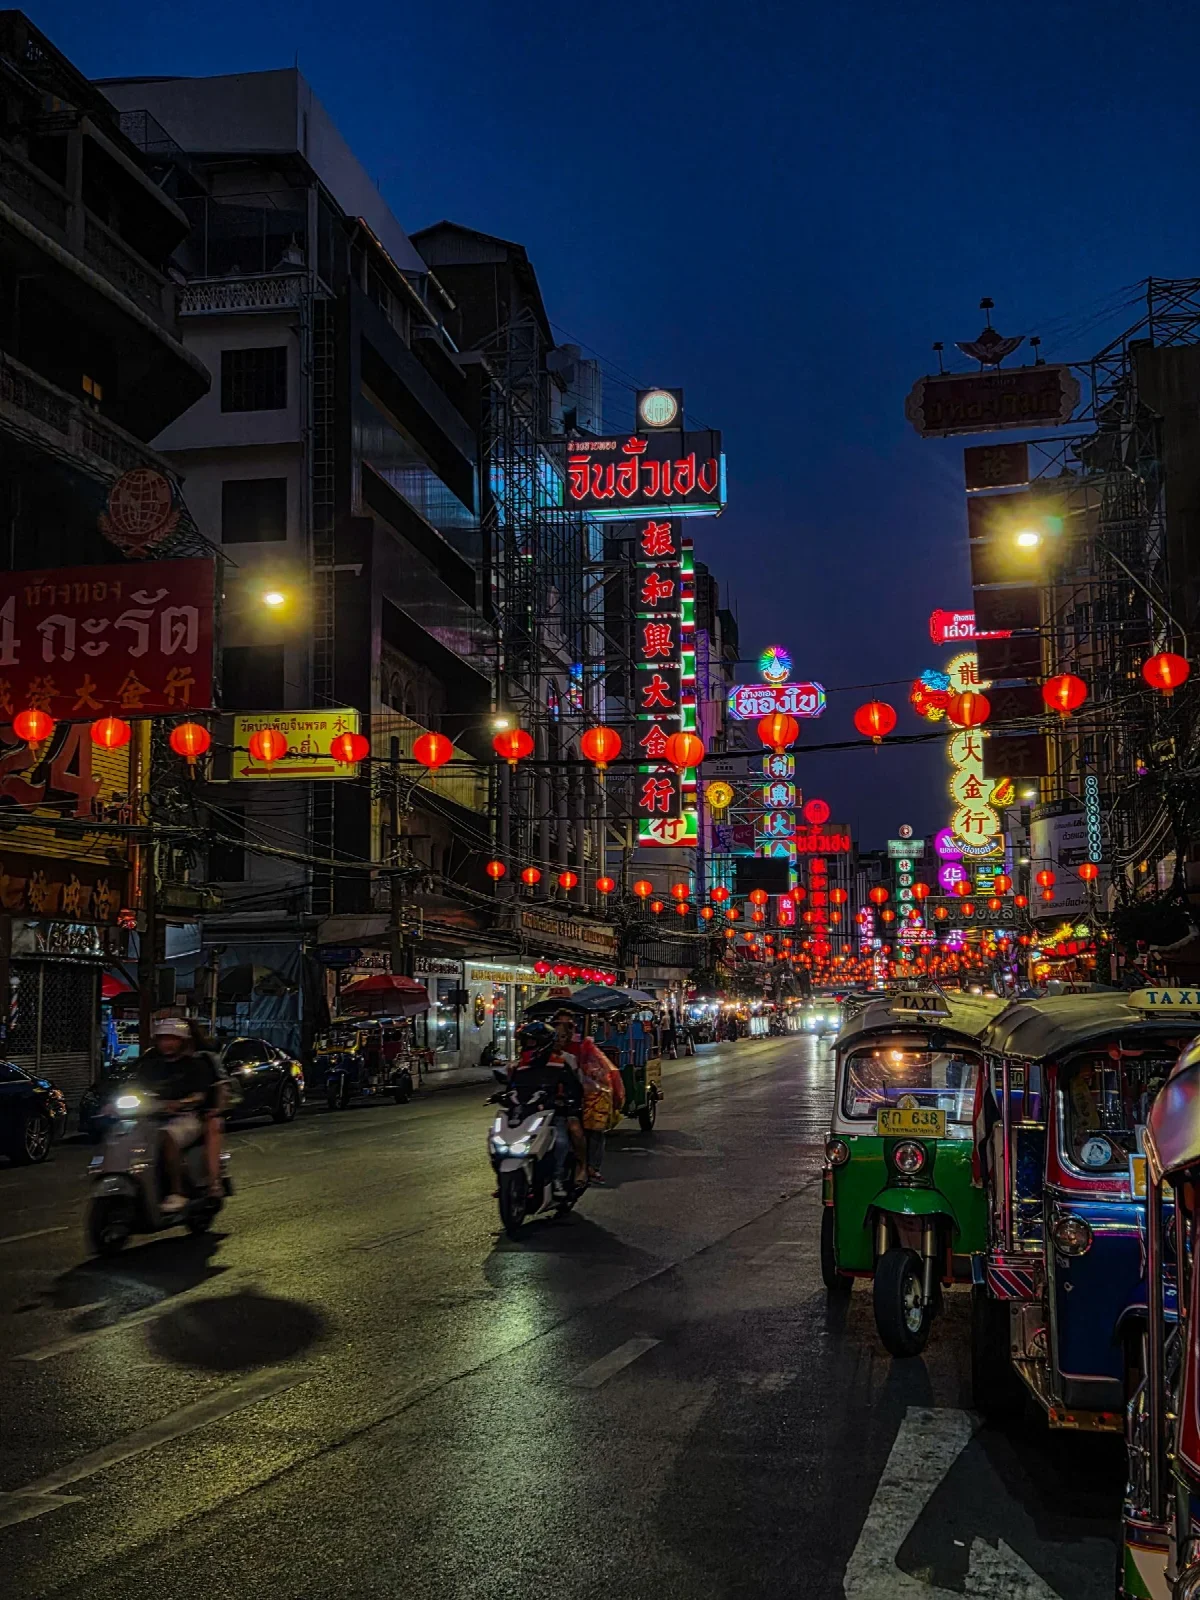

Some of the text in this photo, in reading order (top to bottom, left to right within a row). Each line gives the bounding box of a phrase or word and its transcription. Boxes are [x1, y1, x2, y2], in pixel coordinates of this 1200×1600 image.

[567, 436, 718, 501] จินฮั้วเฮง
[36, 588, 200, 663] กะรัต
[956, 660, 991, 835] 龍大金行
[1087, 776, 1101, 861] GOLDSMITH
[901, 996, 939, 1010] TAXI
[1146, 991, 1200, 1005] TAXI
[912, 1111, 938, 1125] 638
